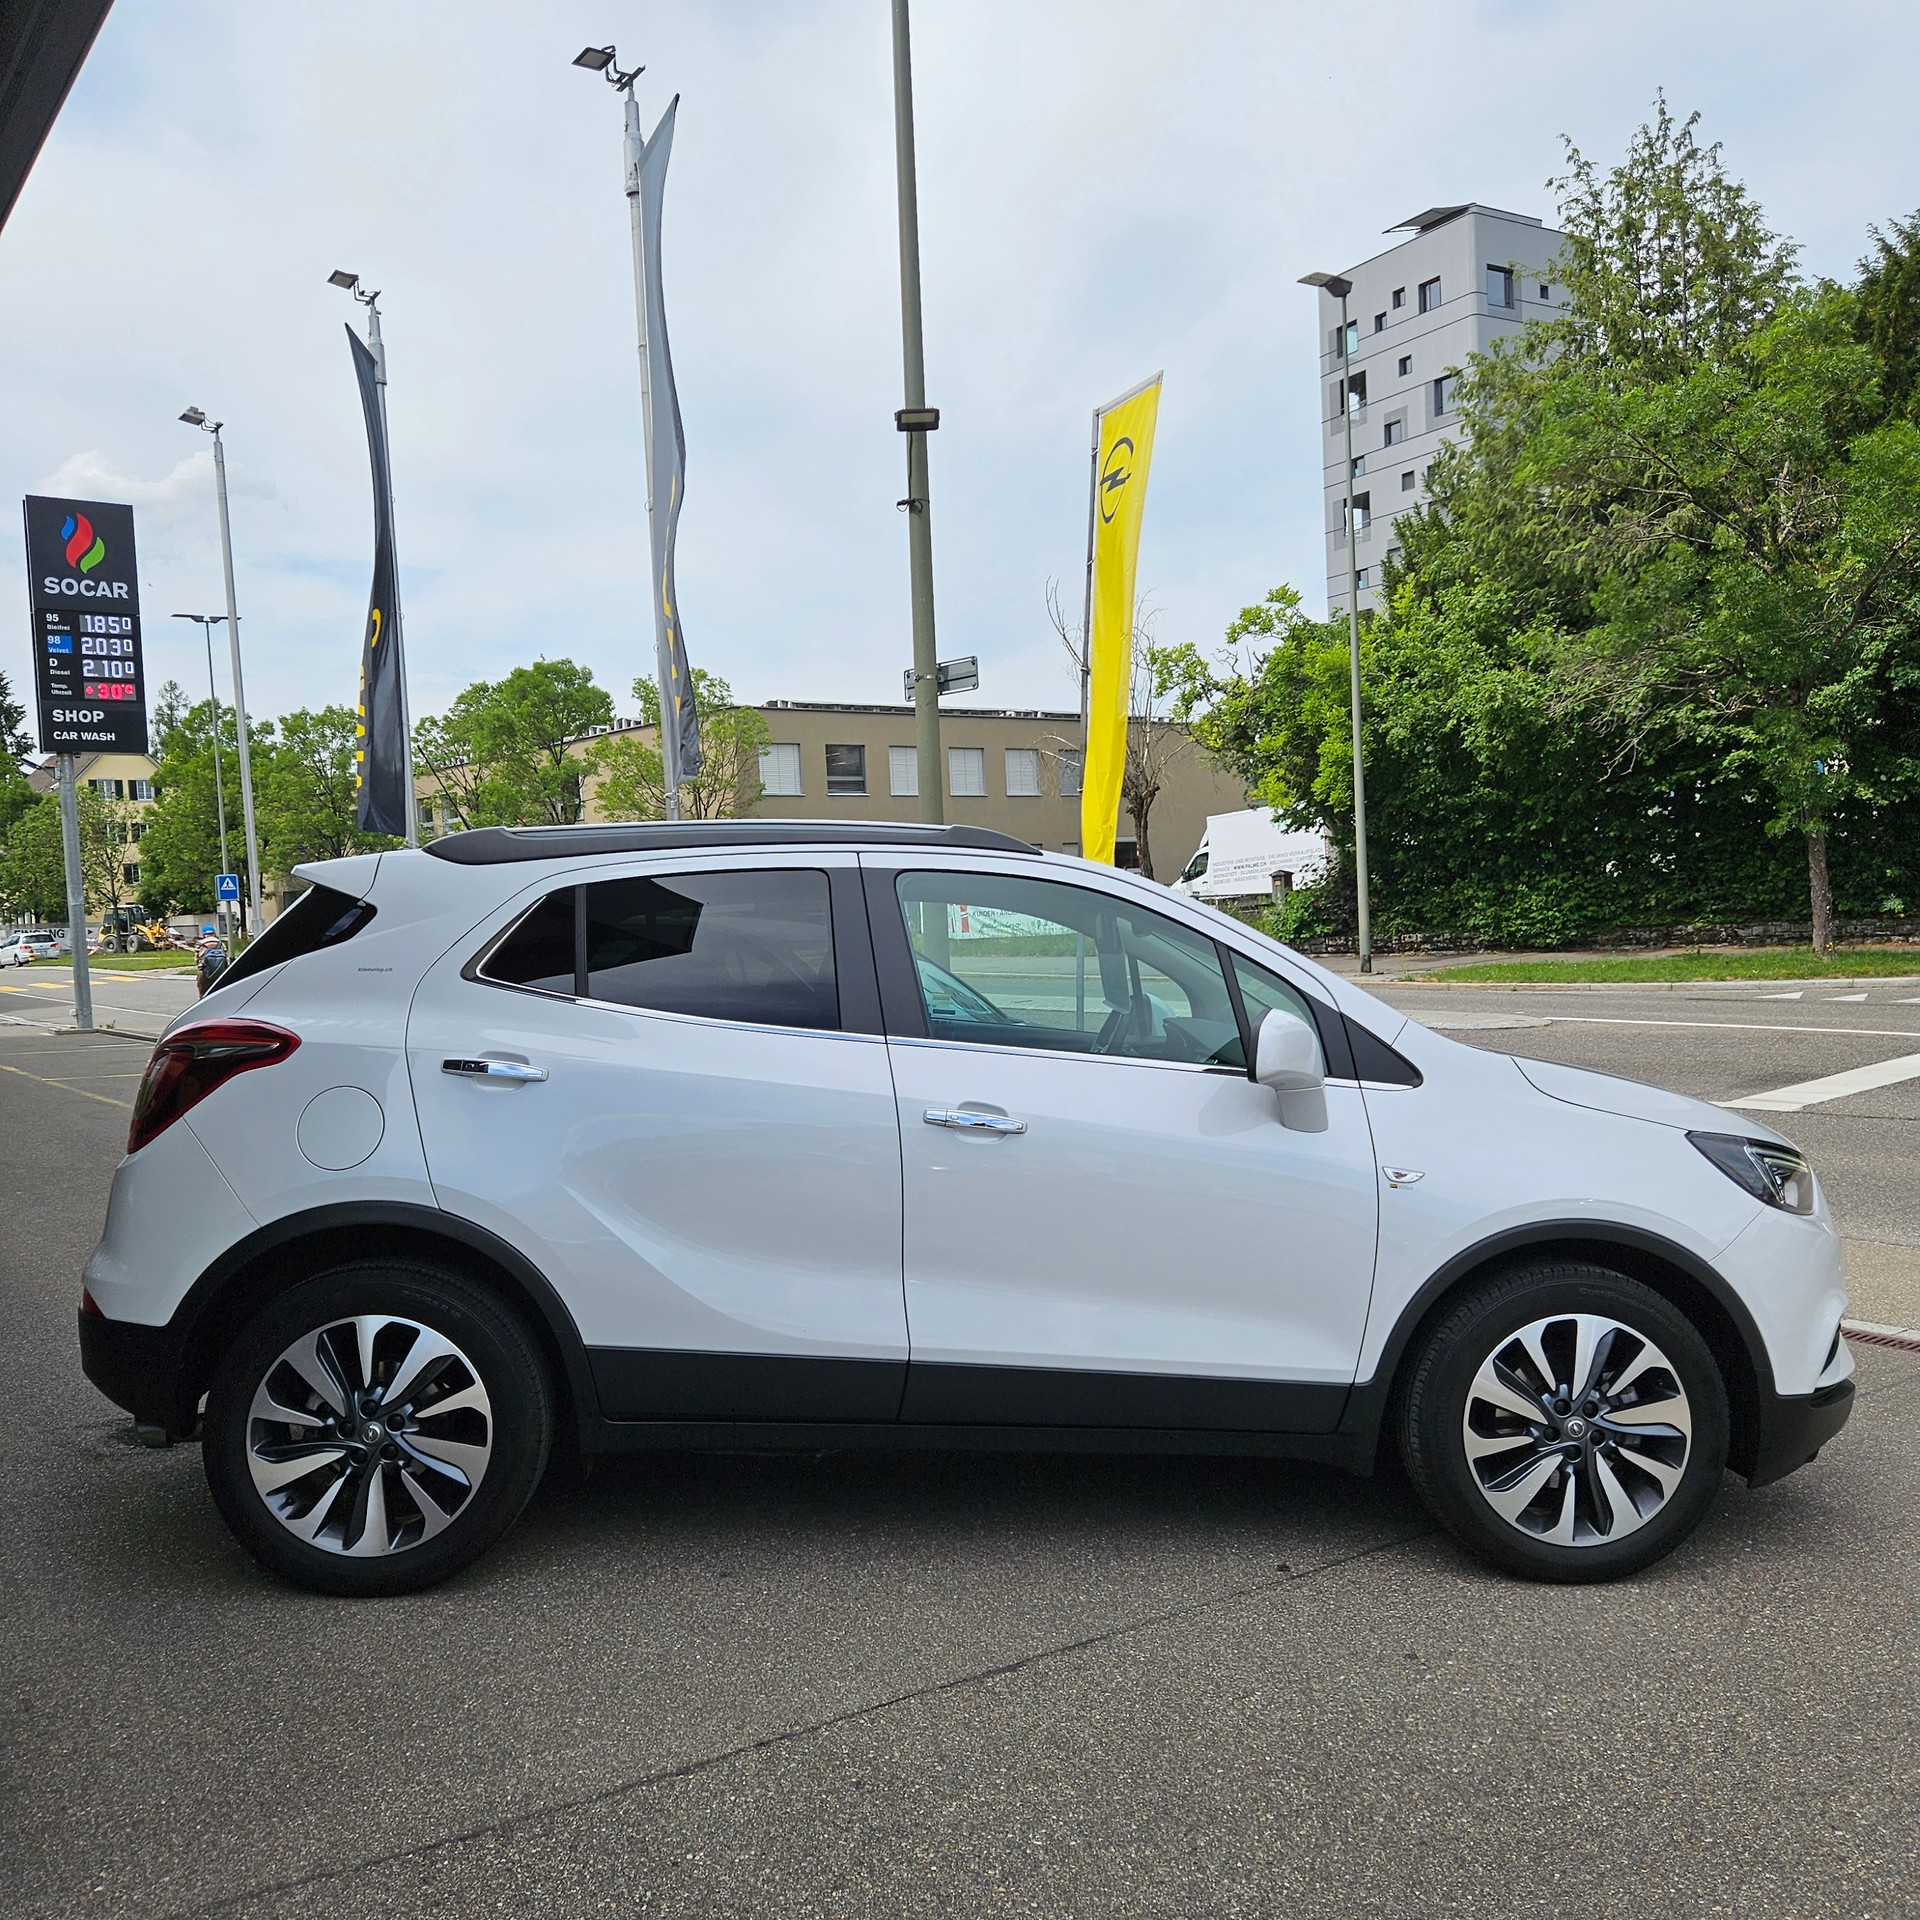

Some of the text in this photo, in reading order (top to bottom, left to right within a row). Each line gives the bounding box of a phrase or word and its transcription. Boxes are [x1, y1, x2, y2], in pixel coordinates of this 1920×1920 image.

[43, 576, 129, 599] SOCAR
[46, 613, 59, 622] 95
[47, 635, 61, 644] 98
[49, 658, 58, 667] D
[49, 668, 71, 676] Diesel
[52, 709, 105, 723] SHOP
[53, 731, 116, 741] CAR WASH
